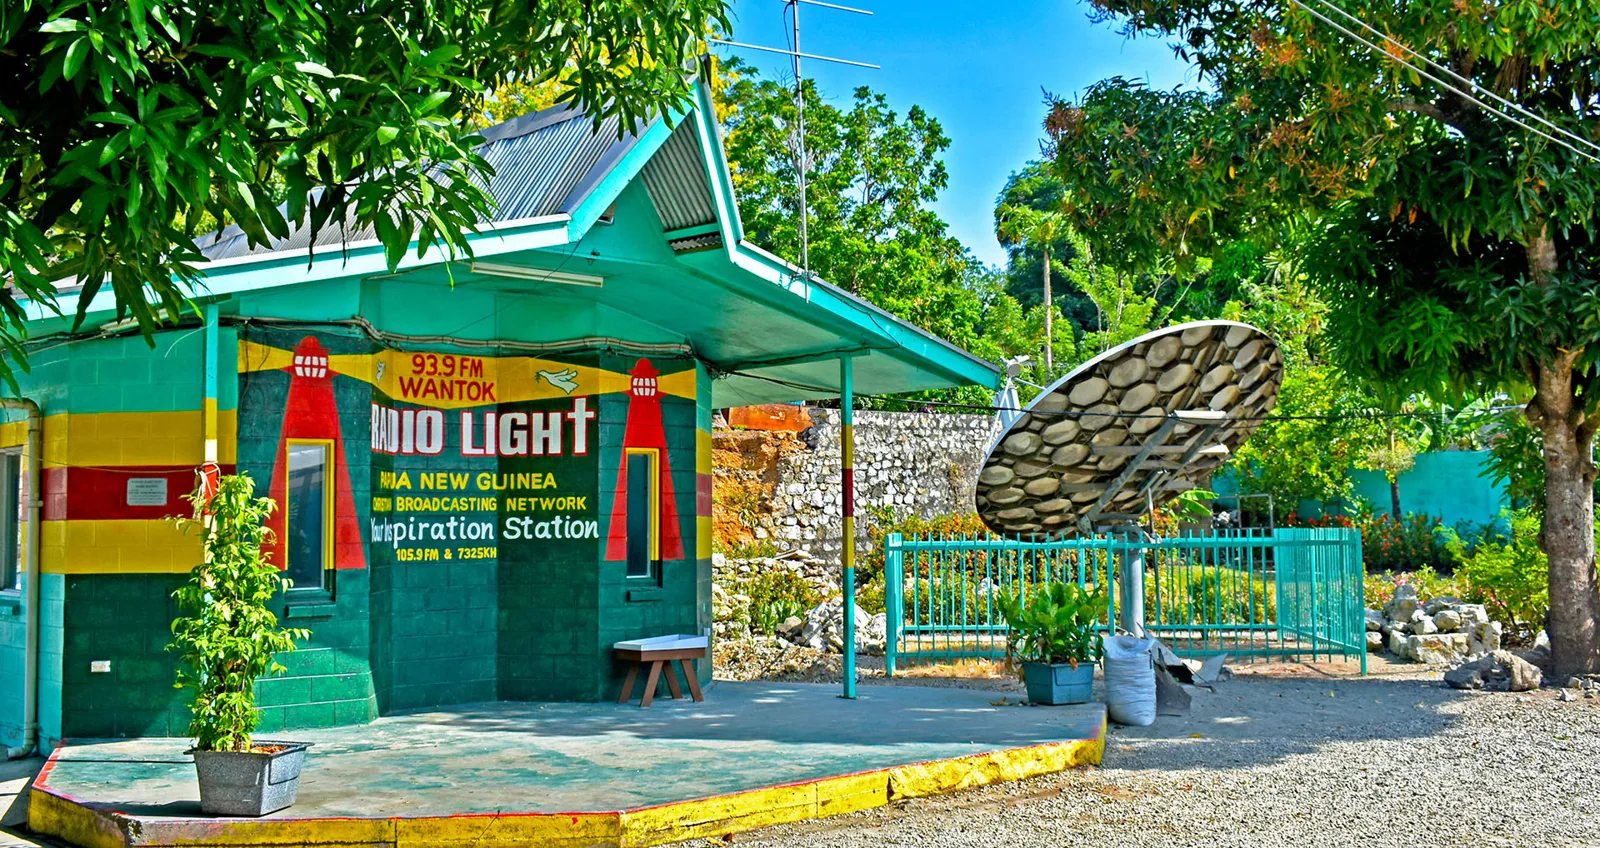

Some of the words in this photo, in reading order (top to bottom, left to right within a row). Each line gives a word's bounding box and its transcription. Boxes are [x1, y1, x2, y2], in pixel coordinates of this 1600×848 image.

[412, 354, 456, 377] 93.9
[460, 357, 483, 378] FM
[399, 376, 496, 402] WANTOK
[371, 400, 445, 456] RADIO
[461, 396, 596, 456] LIGHT
[420, 473, 469, 490] NEW
[476, 472, 557, 490] GUINEA
[396, 496, 497, 512] BROADCASTING
[506, 496, 587, 512] NETWORK
[370, 516, 384, 543] Your
[384, 516, 494, 549] Inspiration
[502, 515, 599, 540] Station
[396, 548, 423, 561] 105.9
[424, 548, 439, 561] FM
[443, 548, 452, 560] &
